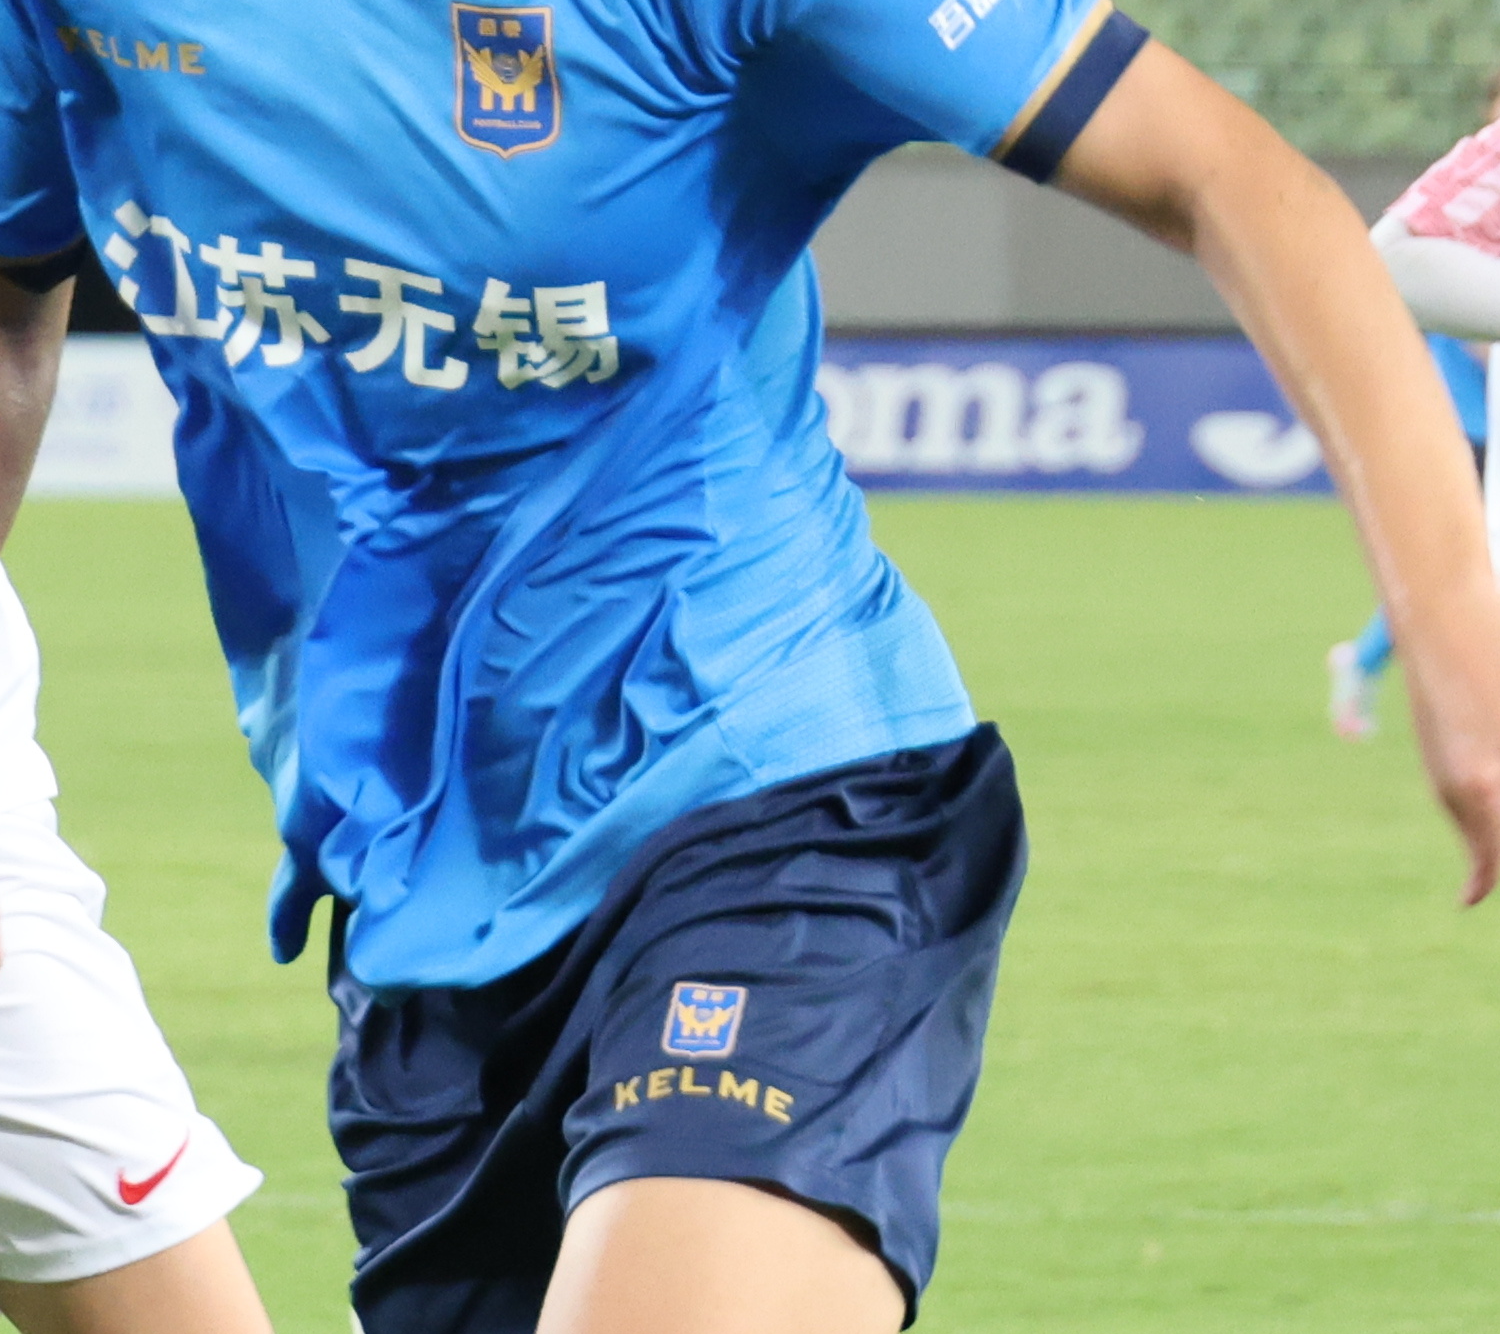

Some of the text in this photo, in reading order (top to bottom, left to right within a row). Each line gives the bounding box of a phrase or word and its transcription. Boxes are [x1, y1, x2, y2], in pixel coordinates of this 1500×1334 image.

[104, 198, 621, 392] 江苏无锡
[613, 1065, 795, 1125] KELME
